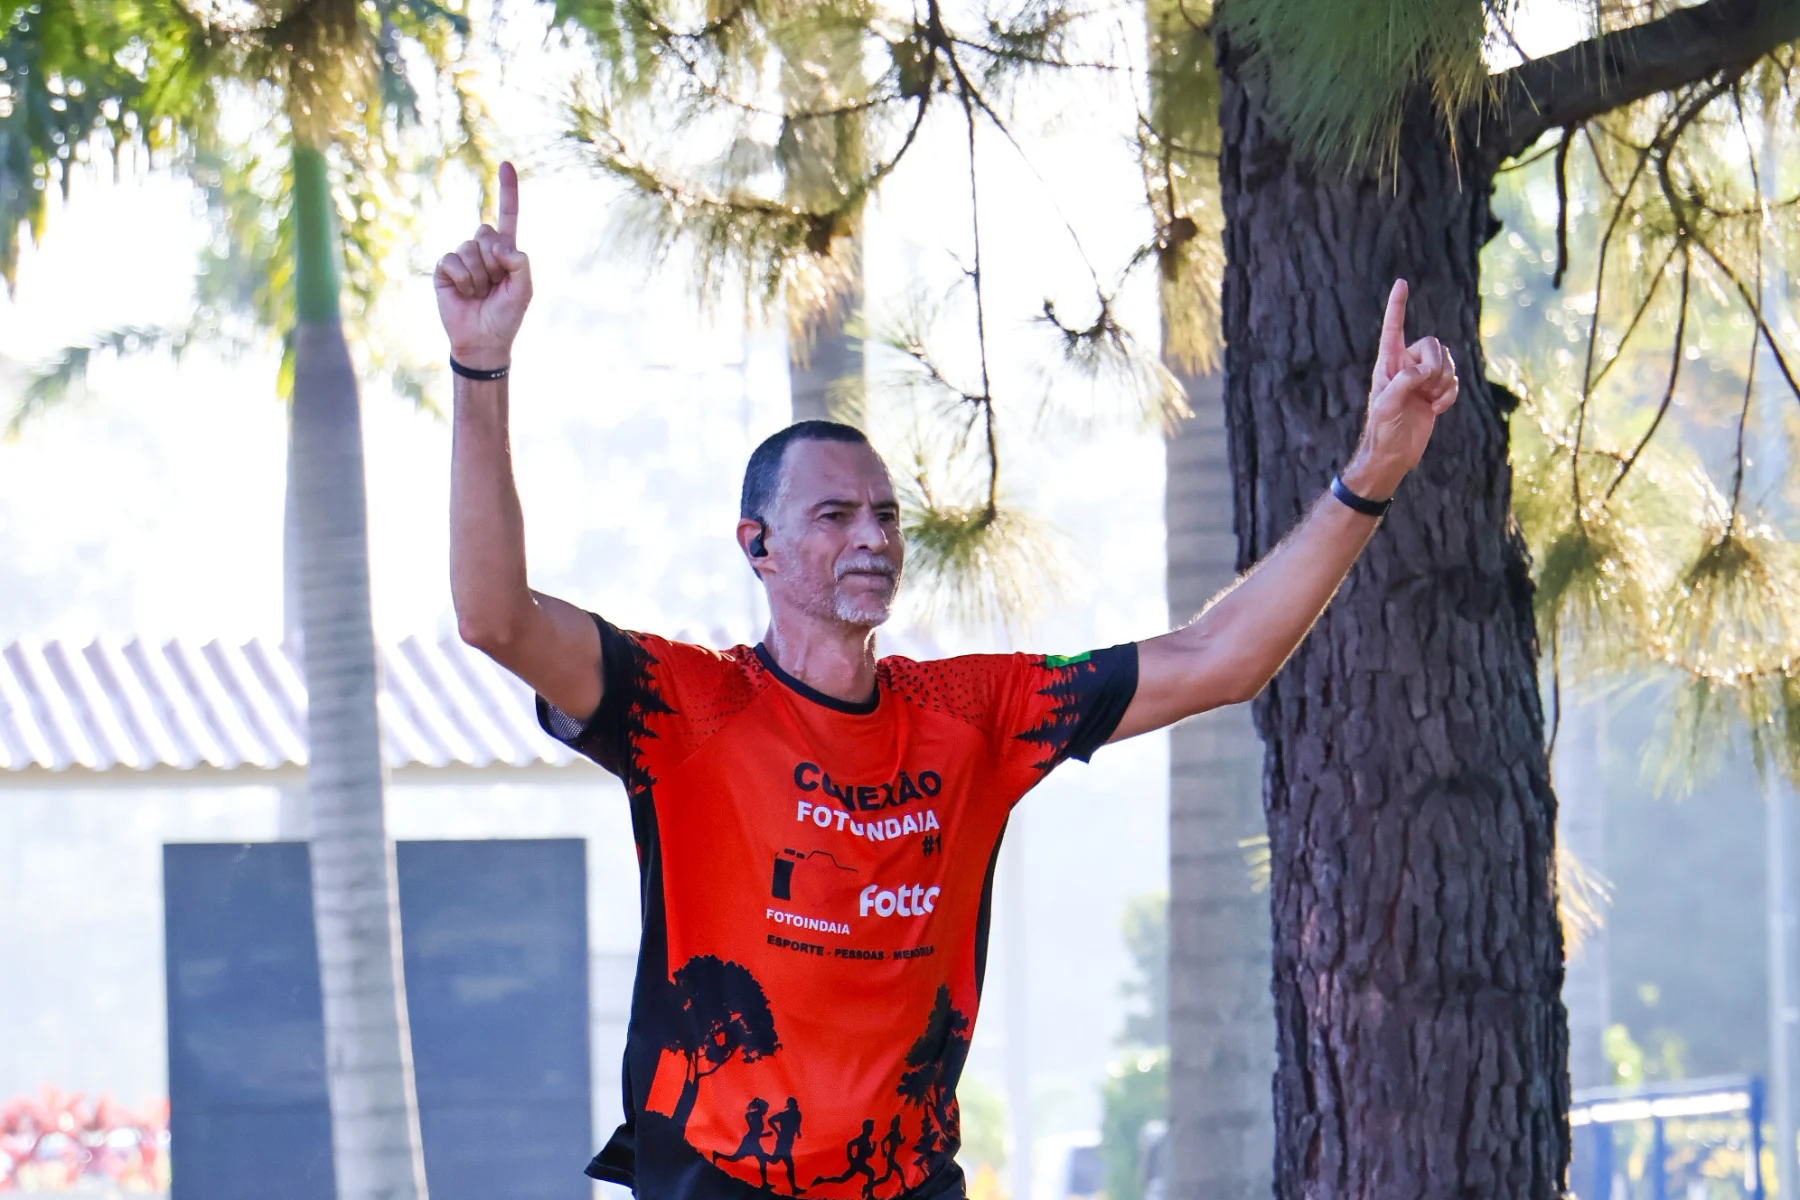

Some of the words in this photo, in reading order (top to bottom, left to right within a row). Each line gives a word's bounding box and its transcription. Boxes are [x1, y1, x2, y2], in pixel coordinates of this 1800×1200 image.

[922, 833, 942, 856] #1
[766, 908, 850, 935] FOTOINDAIA
[767, 934, 824, 956] ESPORTE
[834, 948, 885, 960] PESSOAS
